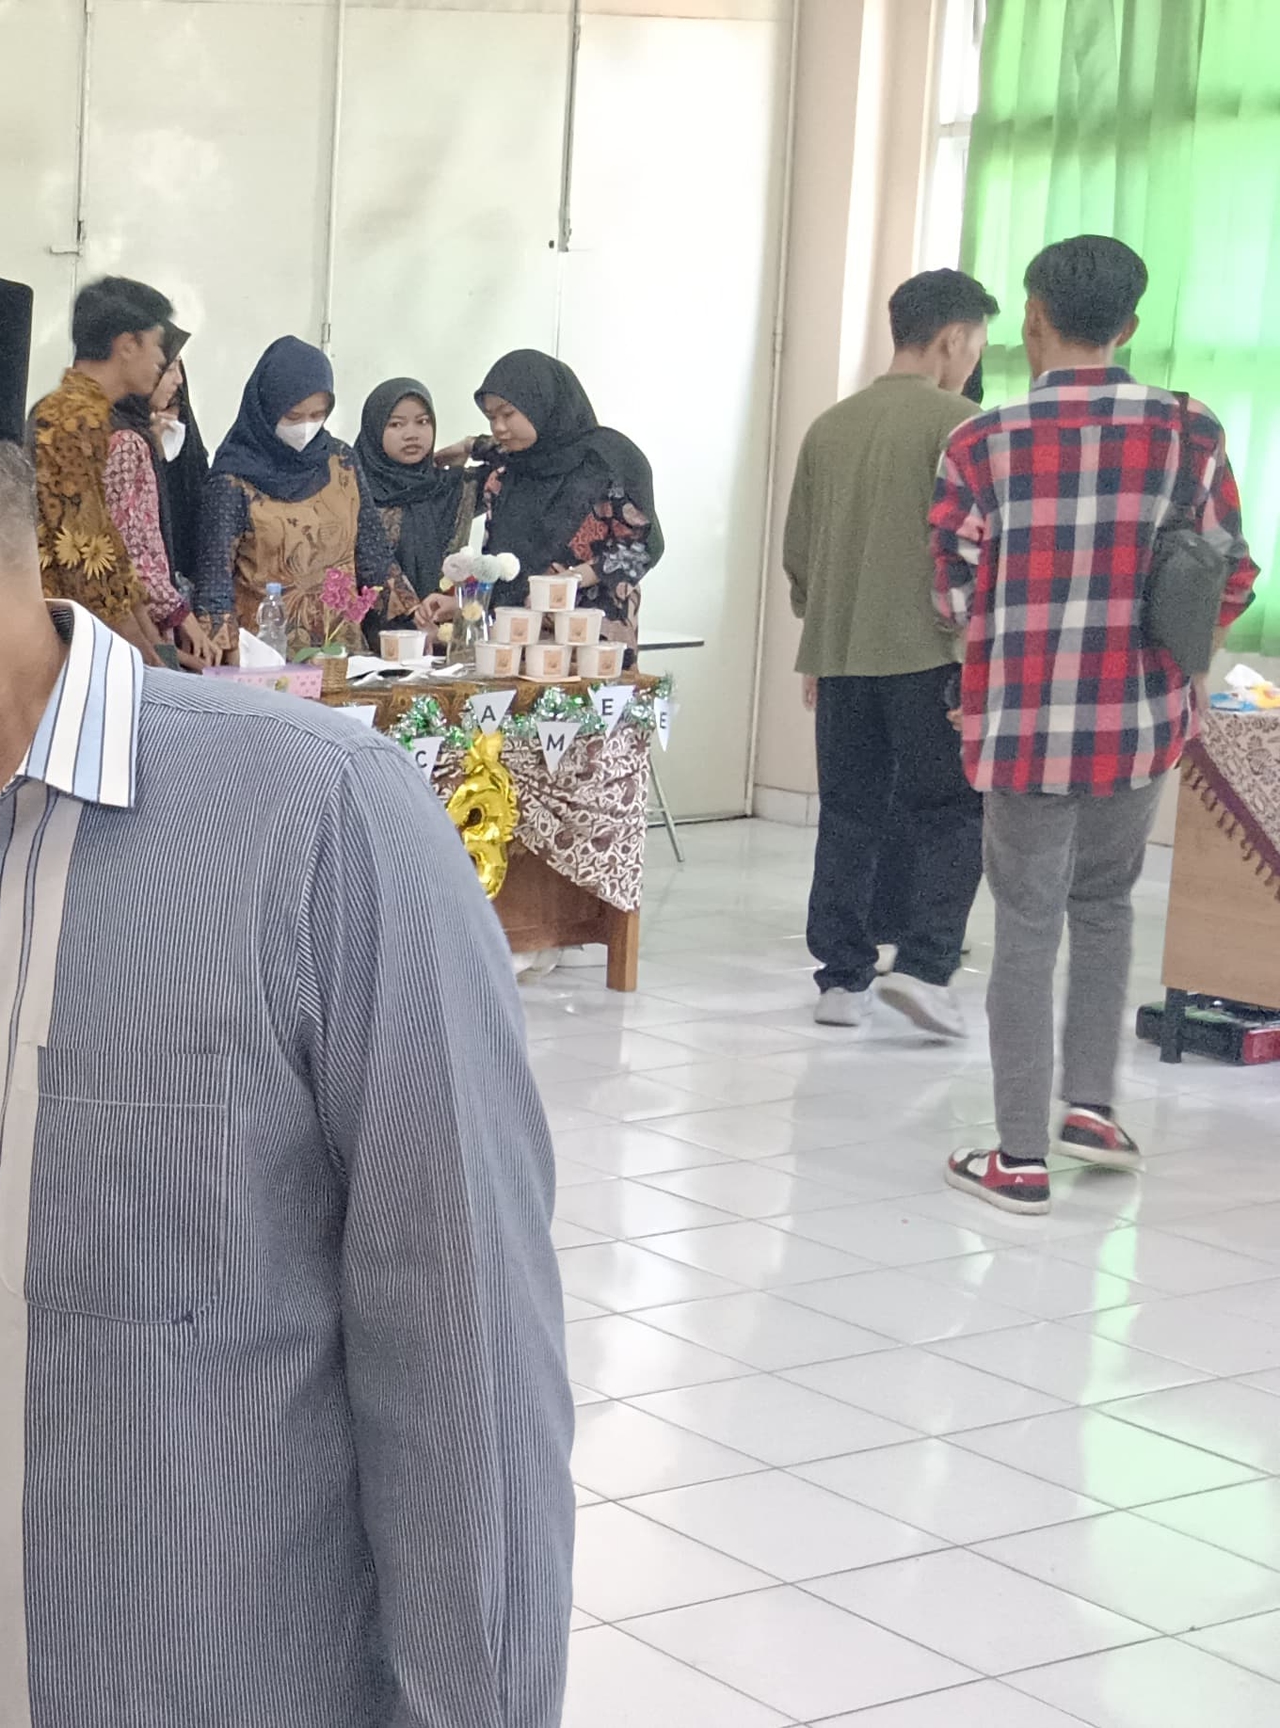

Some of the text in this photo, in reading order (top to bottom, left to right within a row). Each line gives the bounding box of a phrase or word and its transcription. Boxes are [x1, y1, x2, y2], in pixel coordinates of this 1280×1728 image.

[480, 705, 496, 724] A
[546, 733, 565, 752] M
[601, 698, 614, 716] E
